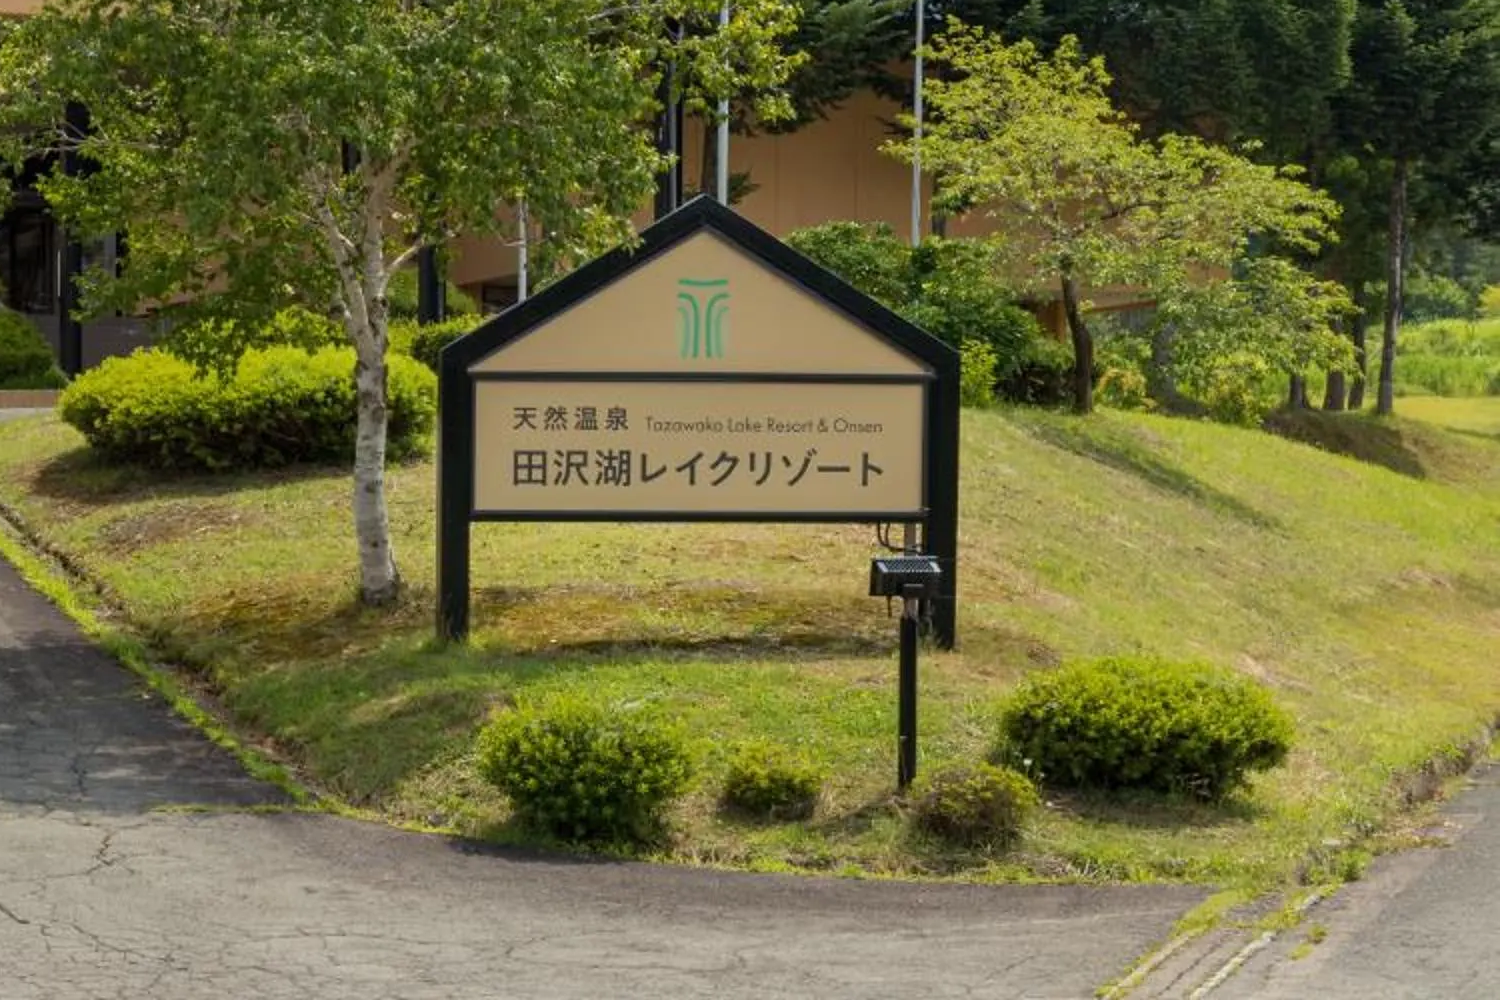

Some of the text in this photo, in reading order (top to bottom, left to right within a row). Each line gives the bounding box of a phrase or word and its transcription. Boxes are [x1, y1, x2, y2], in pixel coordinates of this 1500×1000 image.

[512, 405, 629, 432] 天然温泉
[646, 416, 884, 434] Tazawako Lake Resort & Onsen
[512, 447, 885, 488] 田沢湖レイクリゾート
